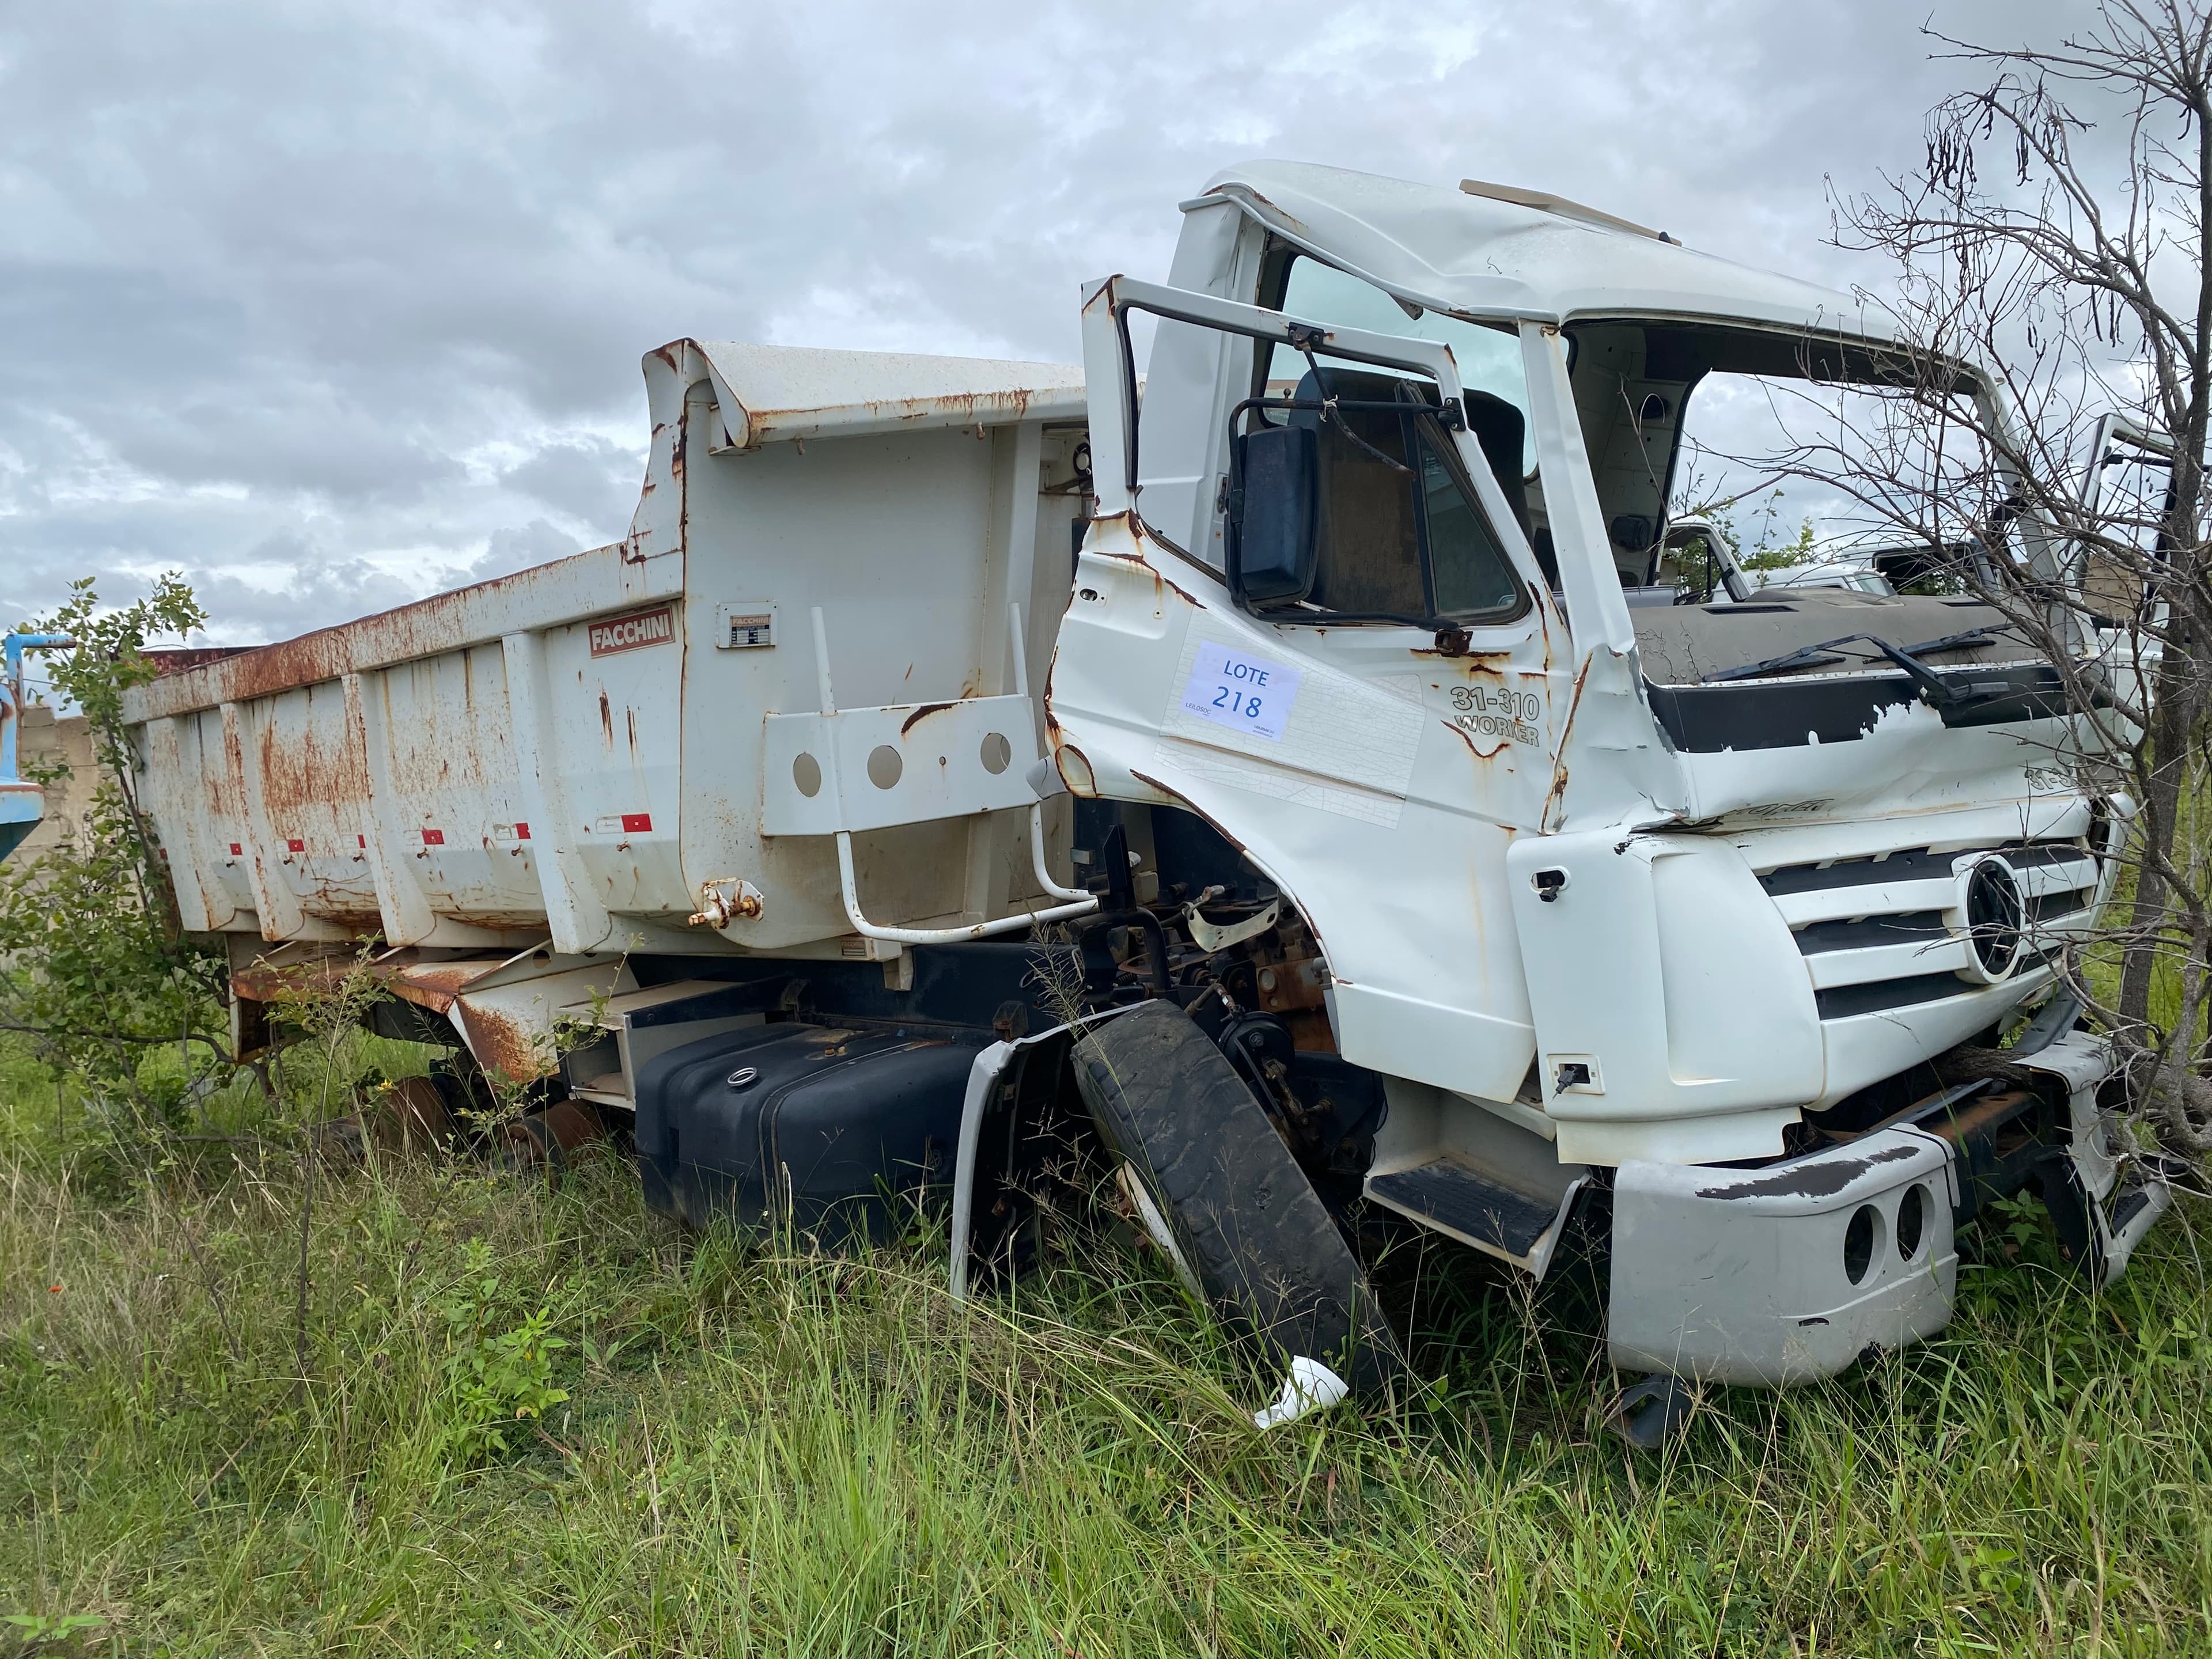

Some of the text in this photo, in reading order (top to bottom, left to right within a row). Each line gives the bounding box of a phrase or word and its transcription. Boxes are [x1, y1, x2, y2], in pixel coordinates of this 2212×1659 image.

[591, 613, 670, 650] FACCHINI
[732, 617, 769, 625] FACCHINI
[1224, 660, 1269, 687] LOTE
[1212, 686, 1262, 718] 218
[1450, 687, 1540, 721] 31-310
[1454, 715, 1540, 748] WORKER
